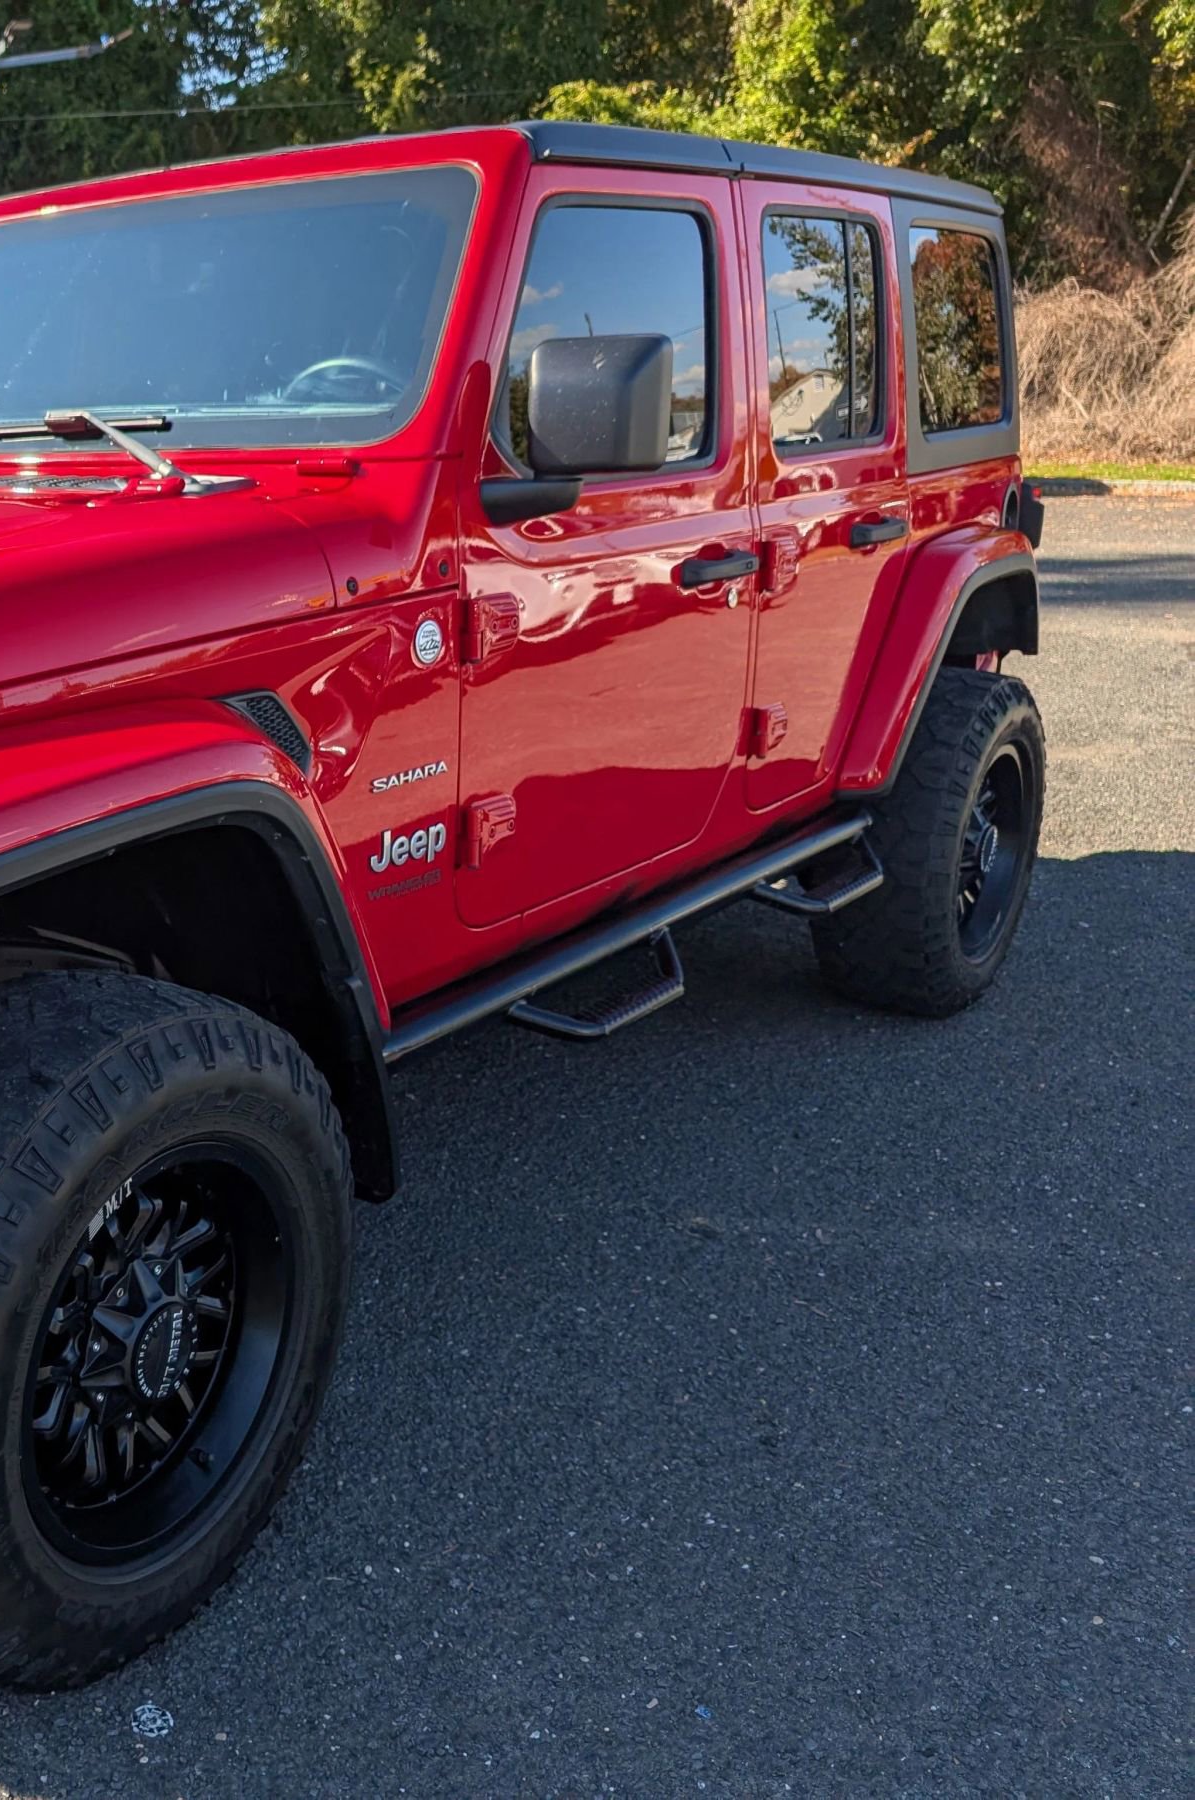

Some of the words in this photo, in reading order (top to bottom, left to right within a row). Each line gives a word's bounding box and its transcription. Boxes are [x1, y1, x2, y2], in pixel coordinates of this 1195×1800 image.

[372, 760, 448, 794] SAHARA
[370, 821, 447, 874] Jeep
[105, 1176, 134, 1220] M/T
[168, 1309, 183, 1363] METAL
